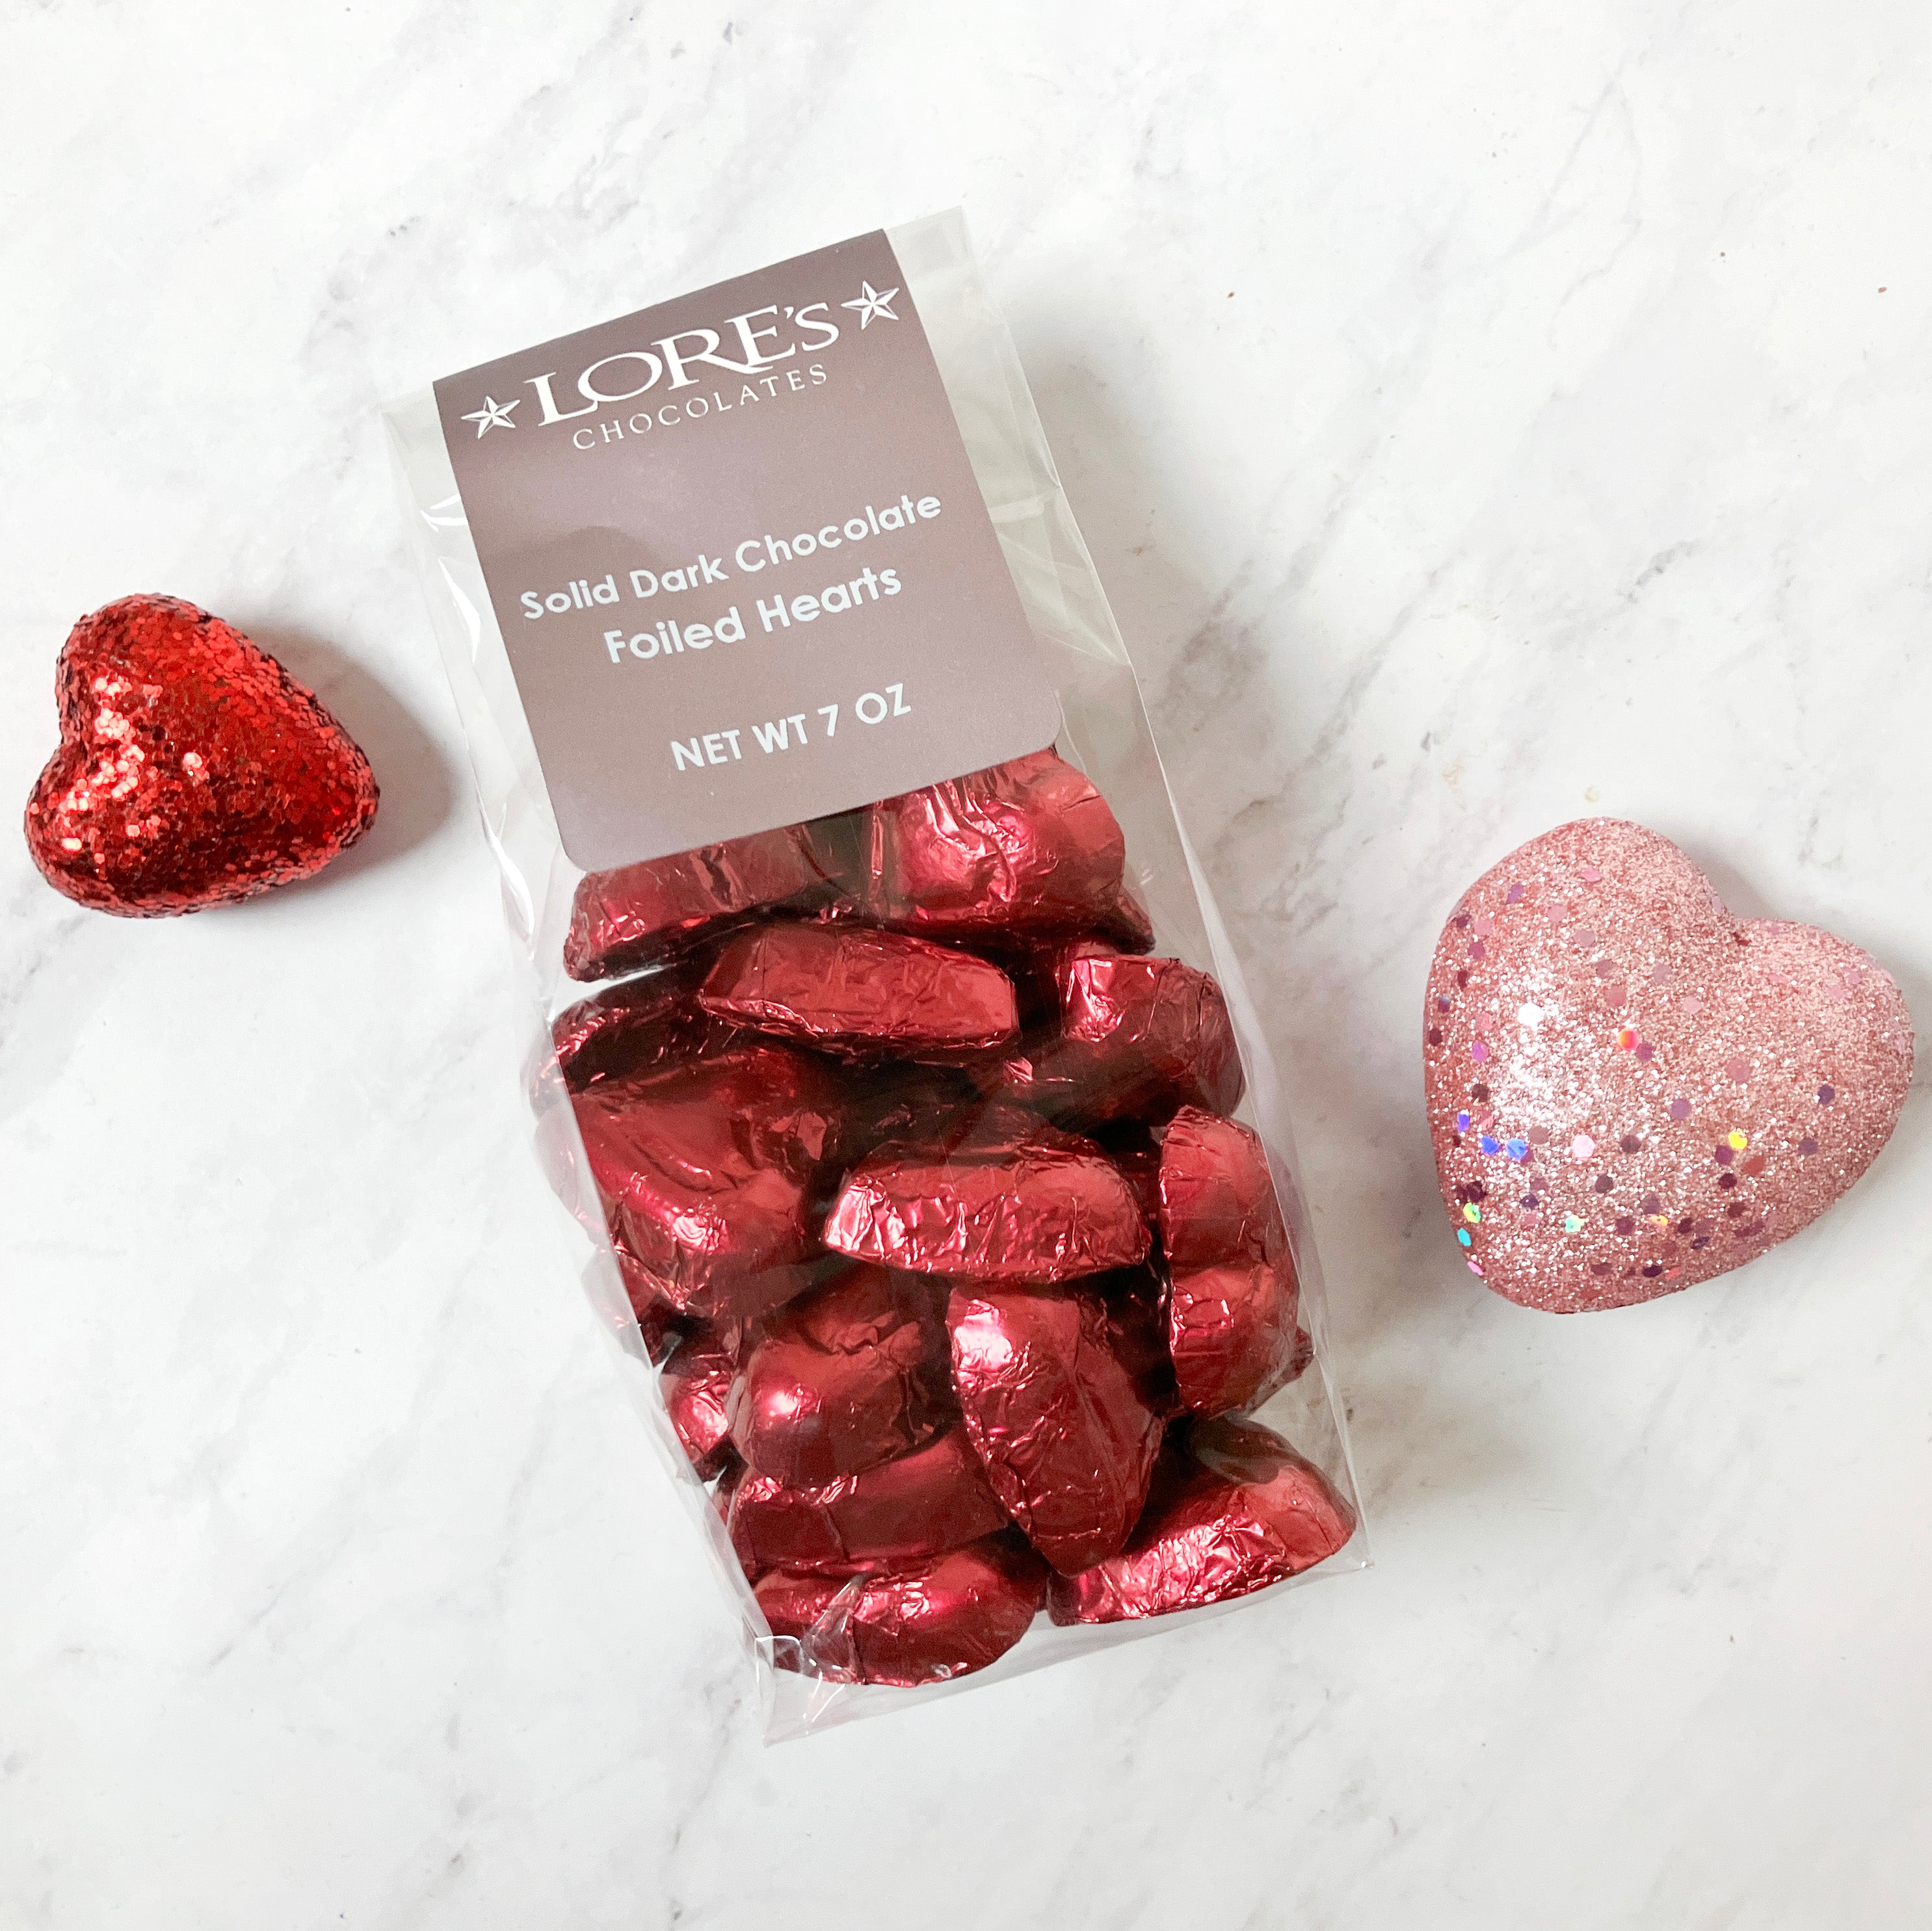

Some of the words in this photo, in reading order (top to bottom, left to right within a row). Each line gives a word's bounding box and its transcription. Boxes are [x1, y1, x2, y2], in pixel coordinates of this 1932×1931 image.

[523, 302, 840, 427] LORE'S
[573, 363, 827, 450] CHOCOLATES
[520, 574, 620, 620] Solid
[629, 554, 730, 598] Dark
[735, 495, 941, 572] Chocolate
[603, 606, 746, 664] Foiled
[756, 566, 902, 633] Hearts
[670, 729, 742, 771] NET
[751, 713, 808, 754] WT
[817, 703, 839, 737] 7
[855, 683, 912, 724] OZ
